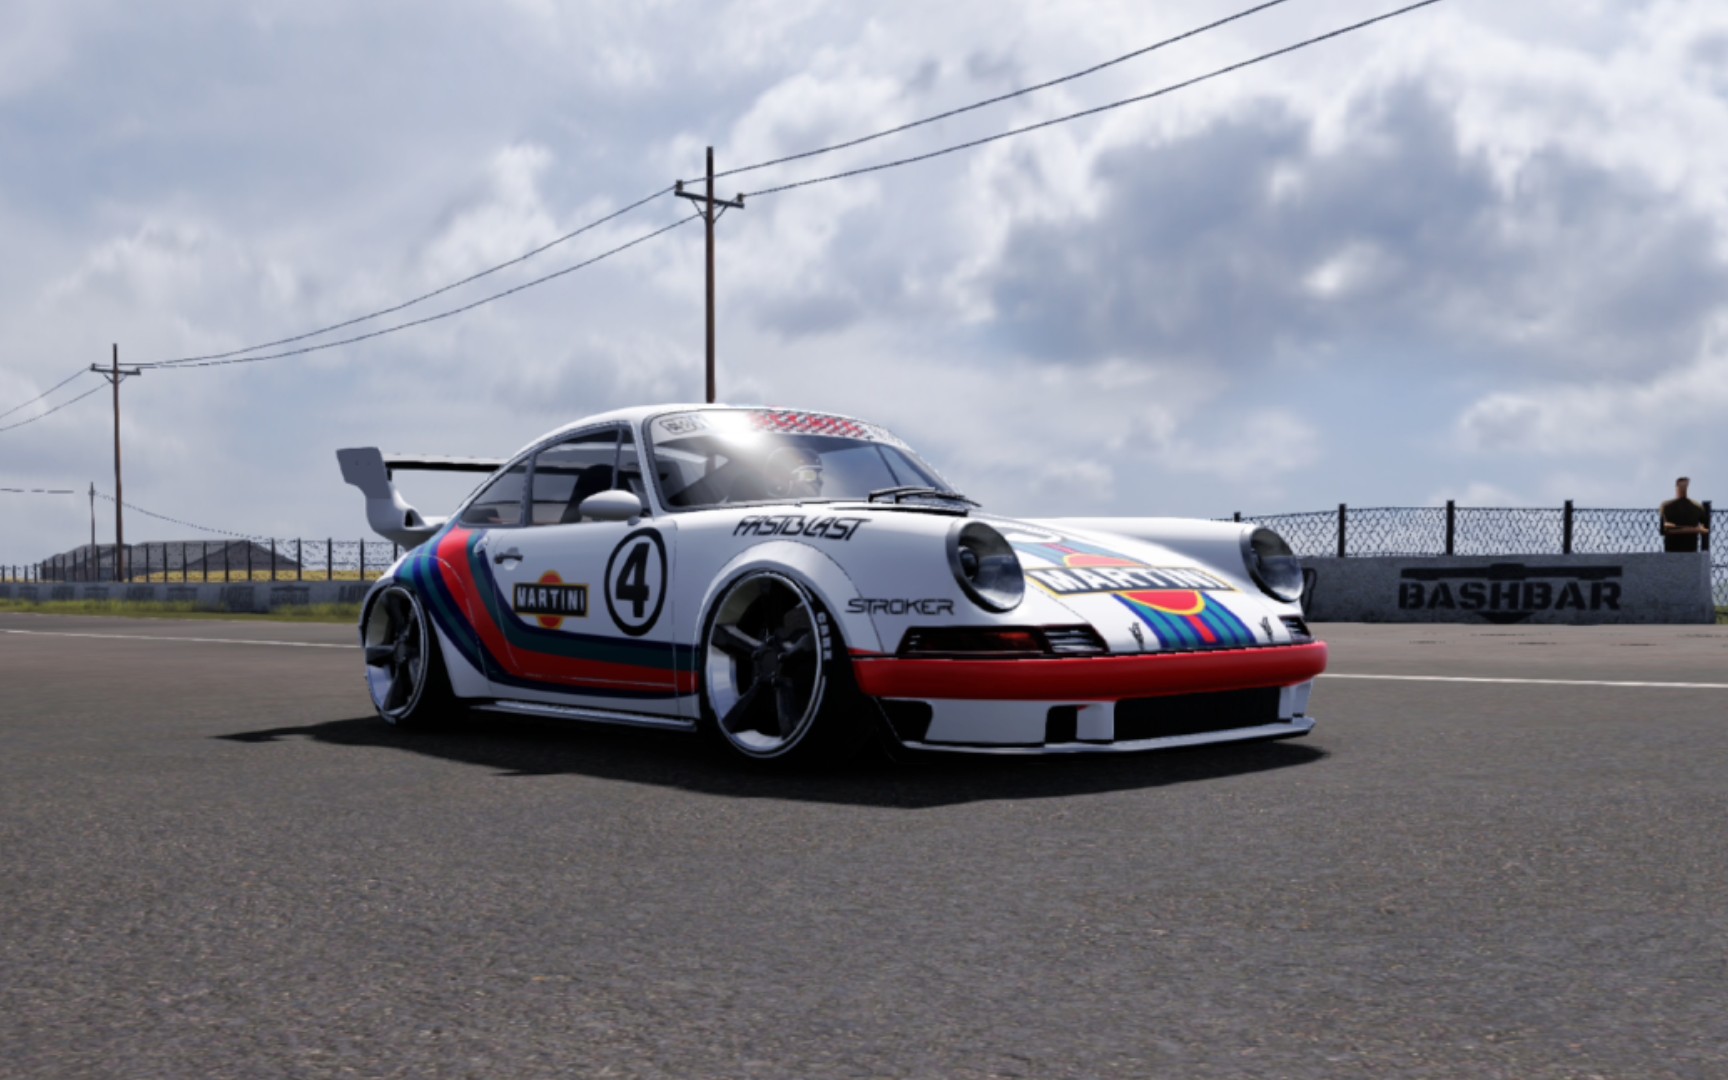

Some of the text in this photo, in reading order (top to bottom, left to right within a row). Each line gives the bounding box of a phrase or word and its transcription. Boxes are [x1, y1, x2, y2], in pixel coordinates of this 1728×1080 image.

[732, 514, 872, 542] FASTBLAST
[615, 542, 650, 619] 4
[1037, 567, 1229, 592] MARTINI
[516, 585, 585, 612] MARTINI
[845, 598, 956, 616] STROKER
[1398, 581, 1622, 610] BASHBAR
